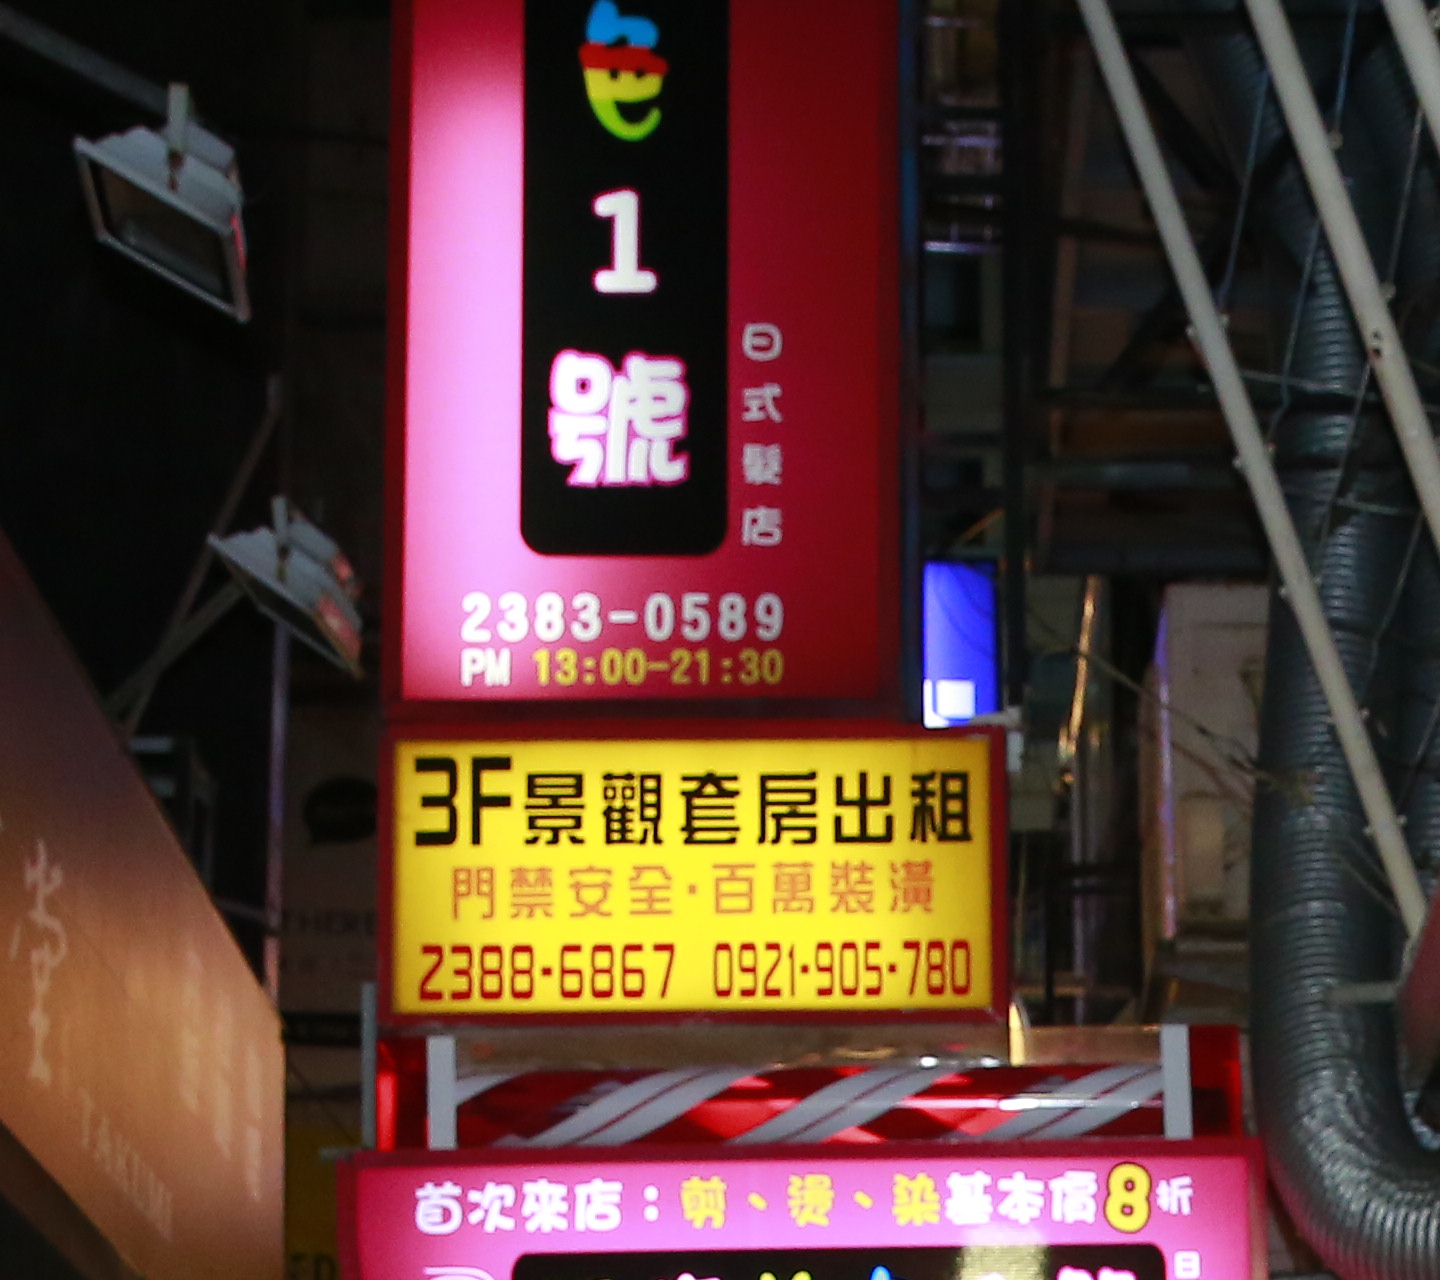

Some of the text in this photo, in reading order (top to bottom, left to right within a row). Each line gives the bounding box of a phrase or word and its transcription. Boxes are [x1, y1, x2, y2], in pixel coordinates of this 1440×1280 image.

[742, 323, 783, 547] 日式髮店
[461, 593, 784, 644] 2383-0589
[461, 648, 784, 687] PM 13:00-21:30
